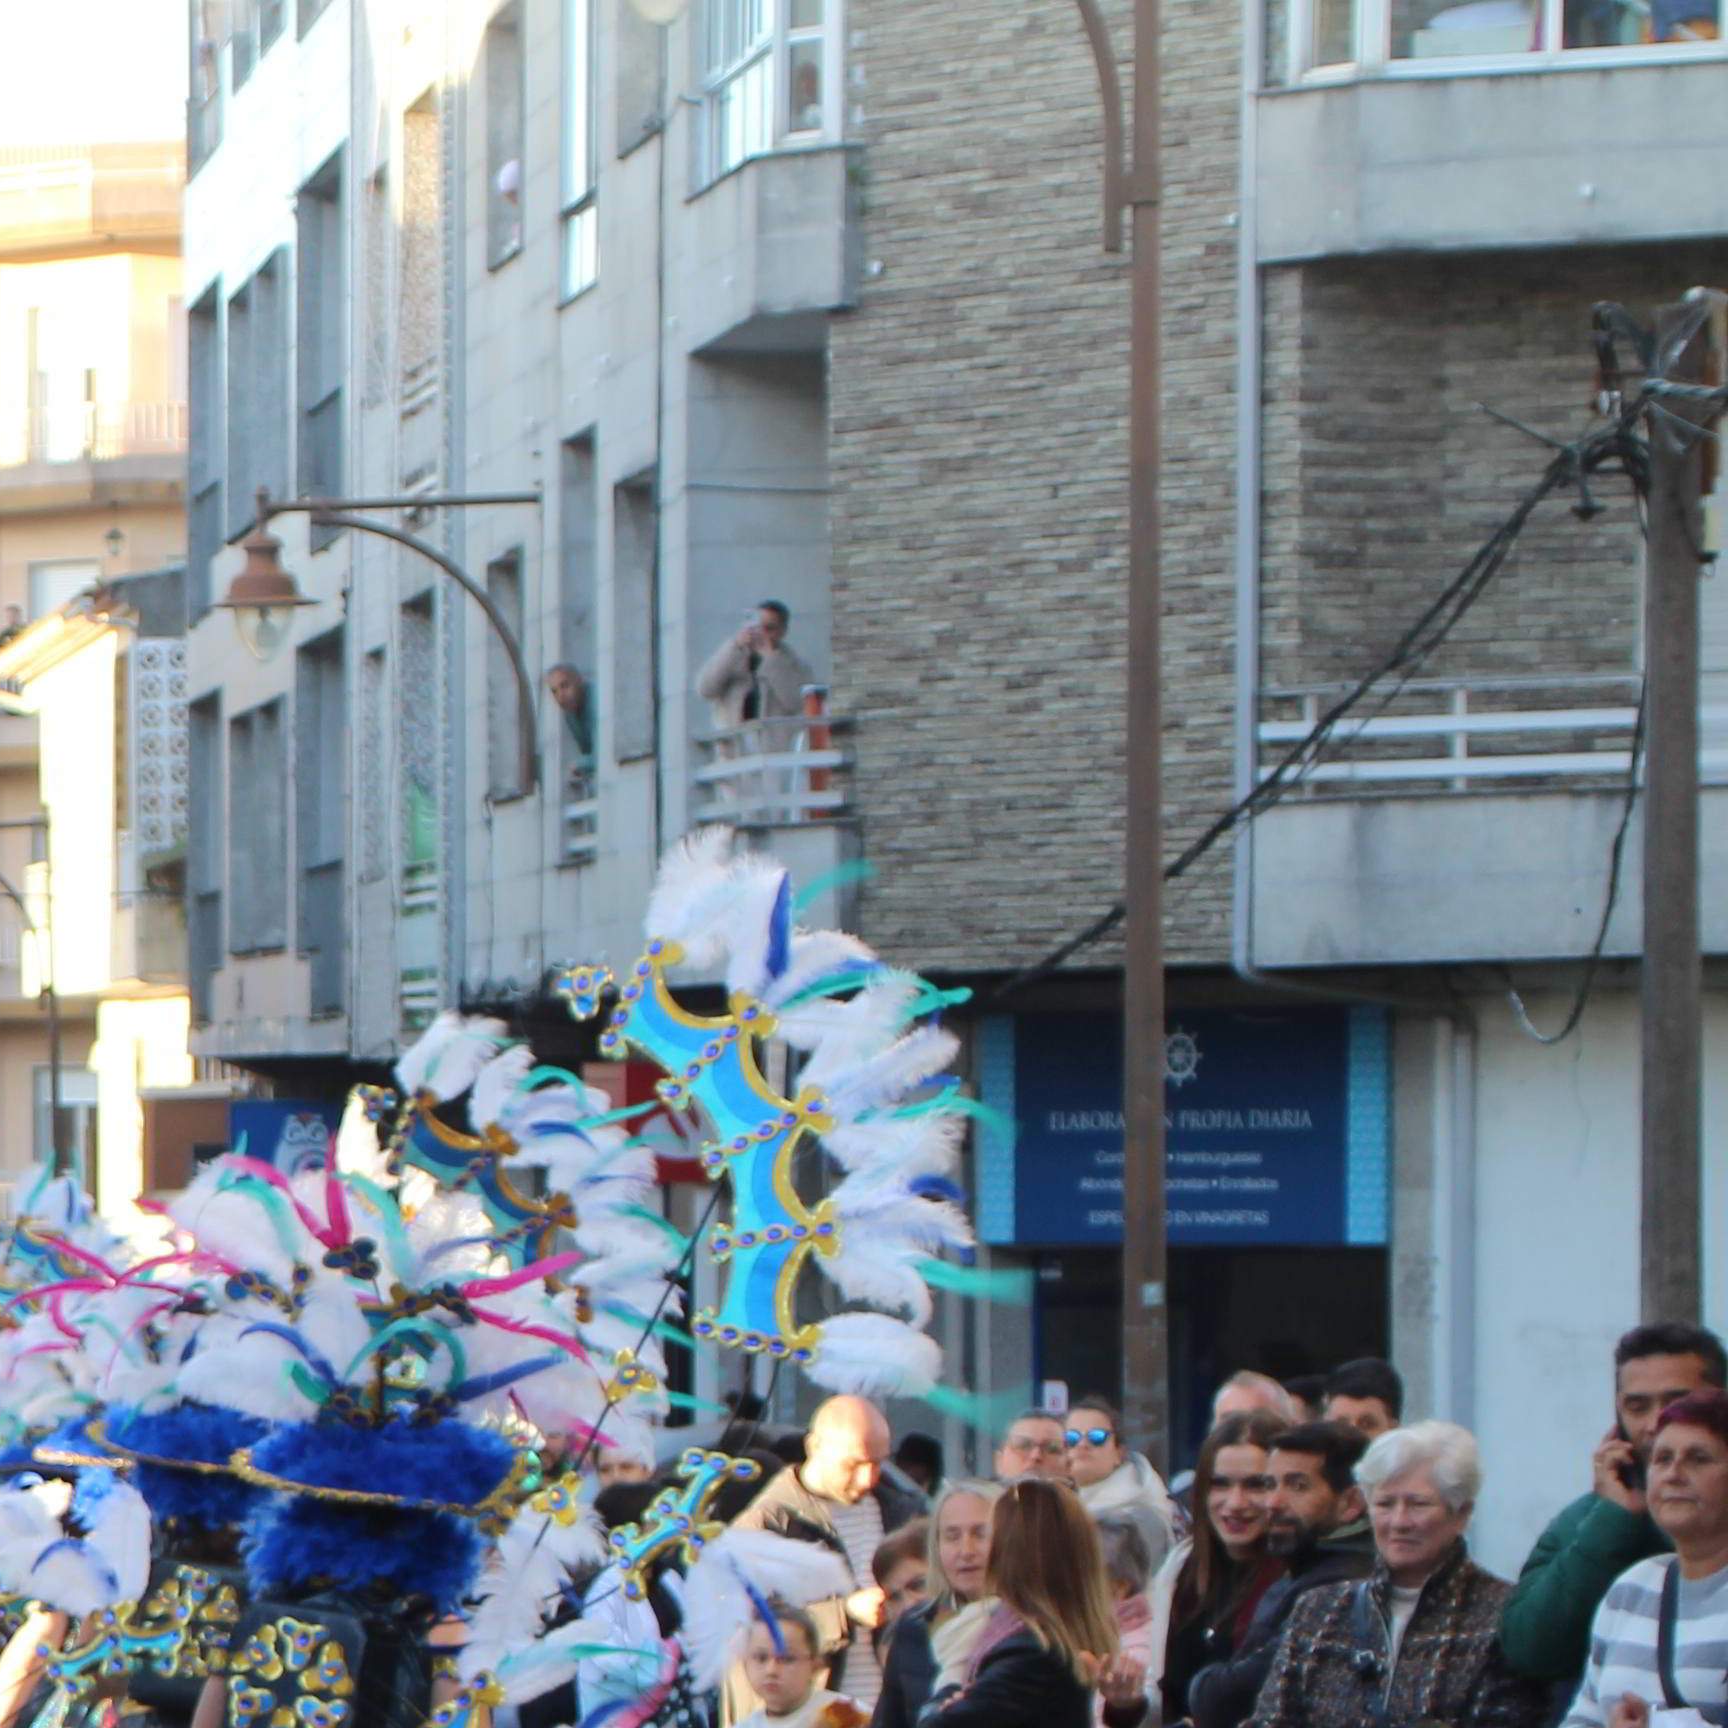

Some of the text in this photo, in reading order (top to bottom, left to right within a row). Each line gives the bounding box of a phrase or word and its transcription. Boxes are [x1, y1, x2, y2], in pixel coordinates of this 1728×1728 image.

[1049, 1108, 1313, 1131] ELABORAN PROPIA DIARIA
